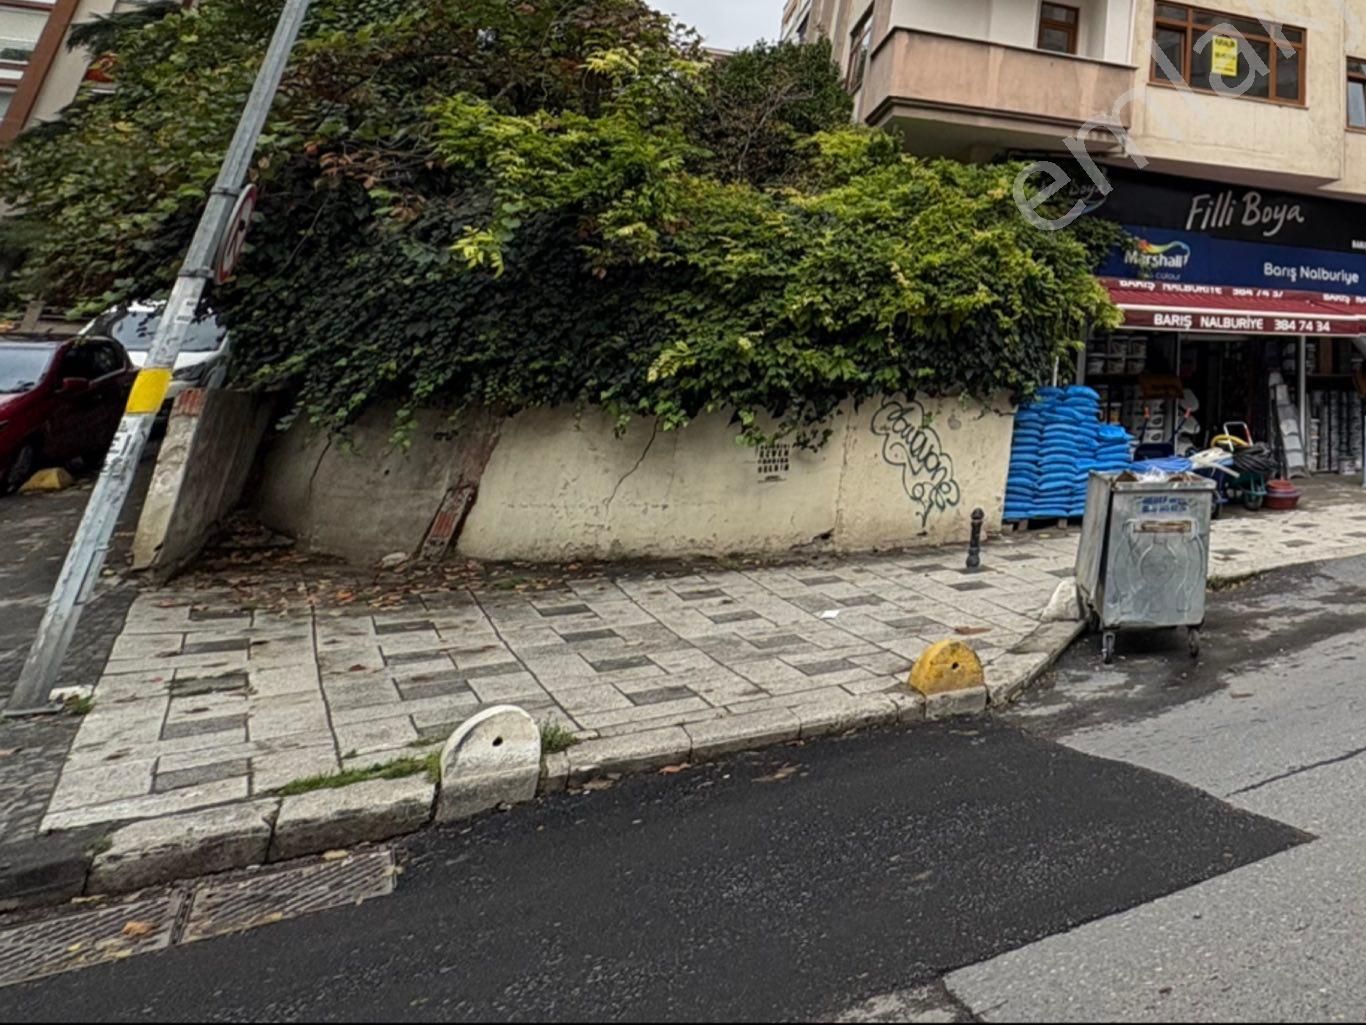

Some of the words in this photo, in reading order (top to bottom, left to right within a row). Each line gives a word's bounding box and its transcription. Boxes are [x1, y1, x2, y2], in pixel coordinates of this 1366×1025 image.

[1185, 190, 1237, 230] Filli
[1241, 191, 1305, 236] Boya
[1263, 262, 1297, 282] Barış
[1300, 266, 1359, 285] Nalburiye
[1153, 313, 1192, 329] BARIŞ
[1200, 314, 1263, 329] NALBURİYE
[1274, 319, 1296, 331] 384
[1299, 321, 1314, 331] 74
[1316, 321, 1331, 332] 34
